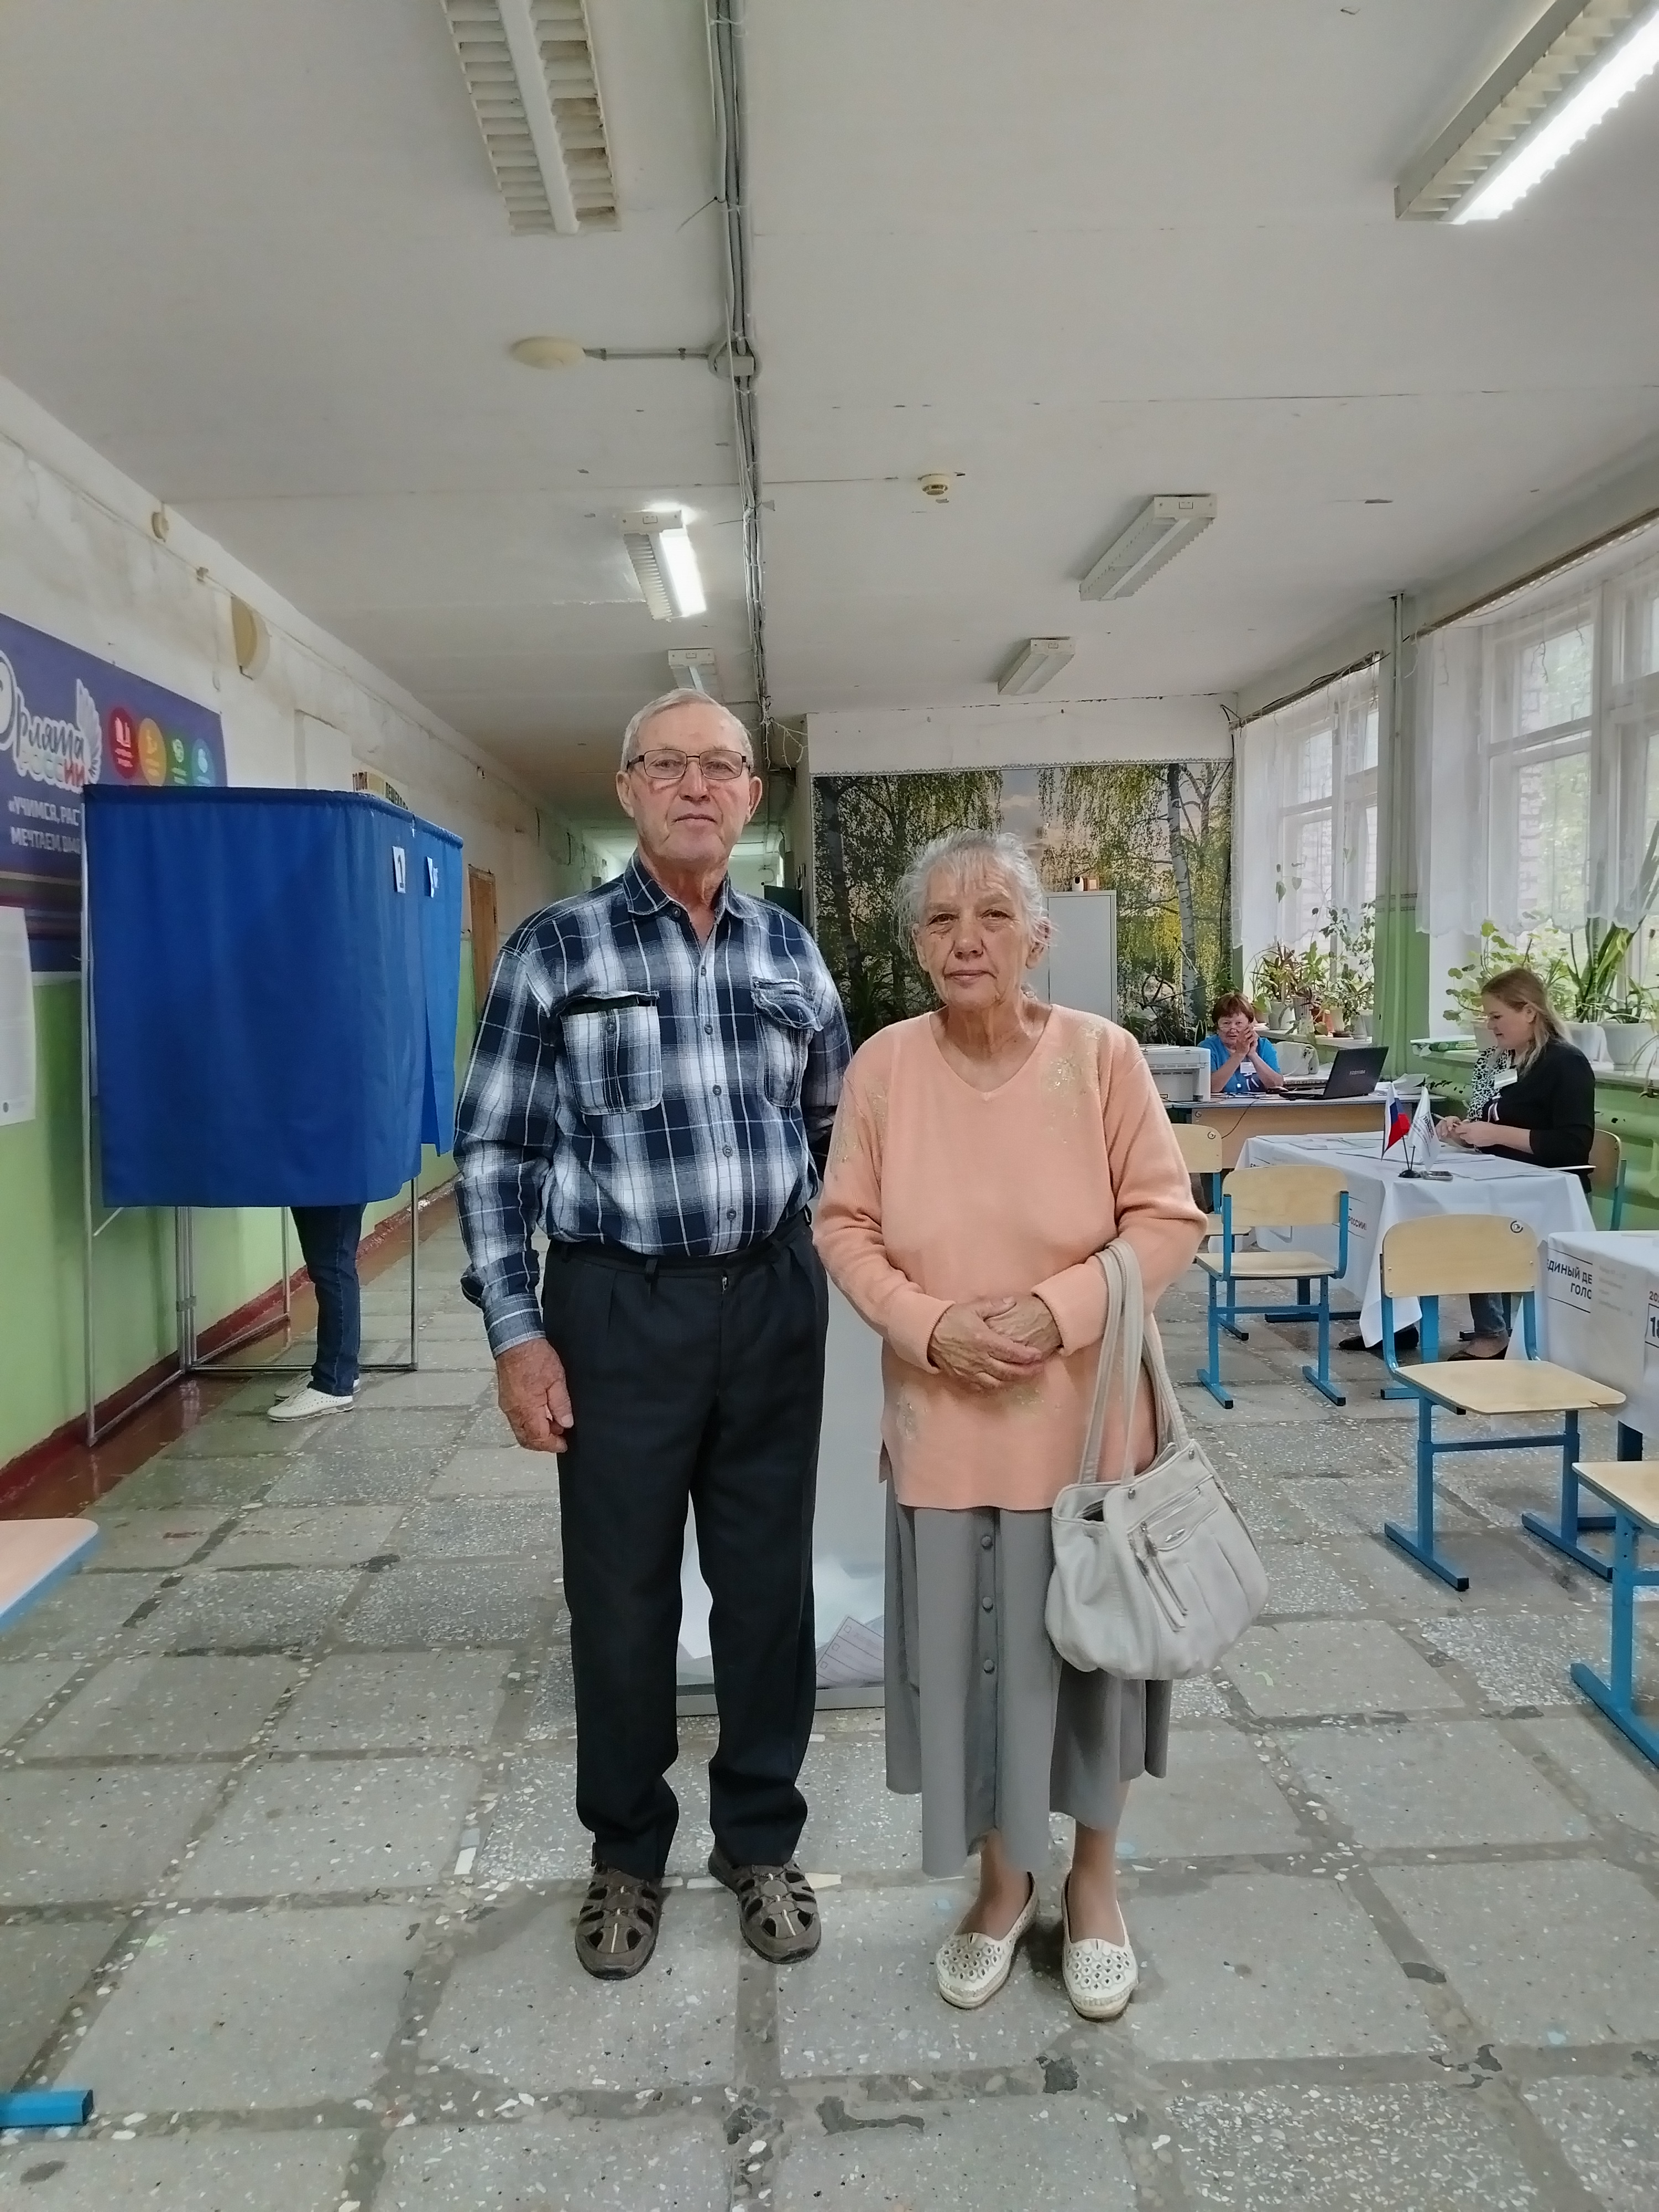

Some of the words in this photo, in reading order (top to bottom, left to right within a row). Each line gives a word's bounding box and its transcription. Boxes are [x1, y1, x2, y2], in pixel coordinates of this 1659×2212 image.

[11, 827, 62, 852] МЕЧТАЕМ
[398, 854, 404, 889] 1
[1582, 1271, 1593, 1285] ДЕ
[1649, 1291, 1659, 1303] 20
